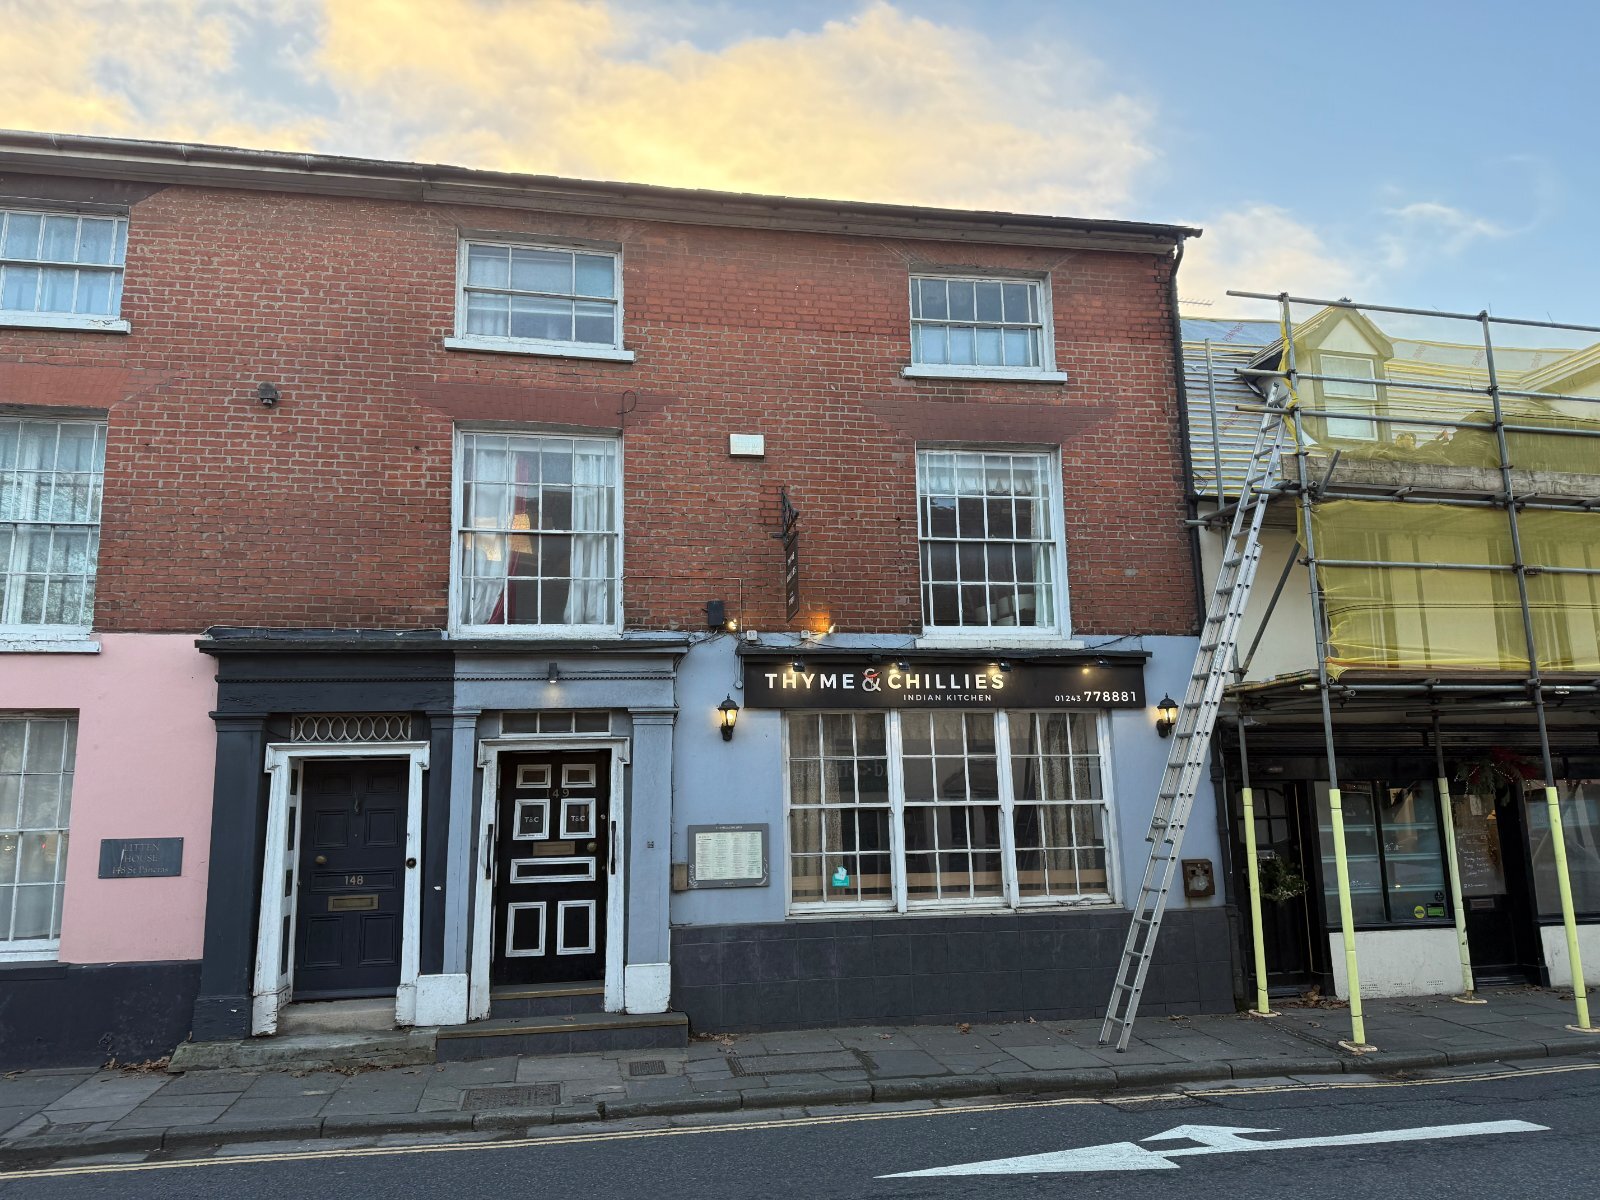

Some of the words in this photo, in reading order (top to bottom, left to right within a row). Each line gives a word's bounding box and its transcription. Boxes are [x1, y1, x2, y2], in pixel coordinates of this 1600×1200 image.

[764, 673, 855, 689] THYME
[861, 668, 882, 692] &
[887, 673, 1004, 690] CHILLIES
[1055, 694, 1081, 702] 01243
[1083, 691, 1137, 702] 778881
[545, 788, 570, 798] 149
[124, 843, 160, 852] LITTEN
[124, 854, 159, 863] HOUSE
[344, 874, 364, 886] 148
